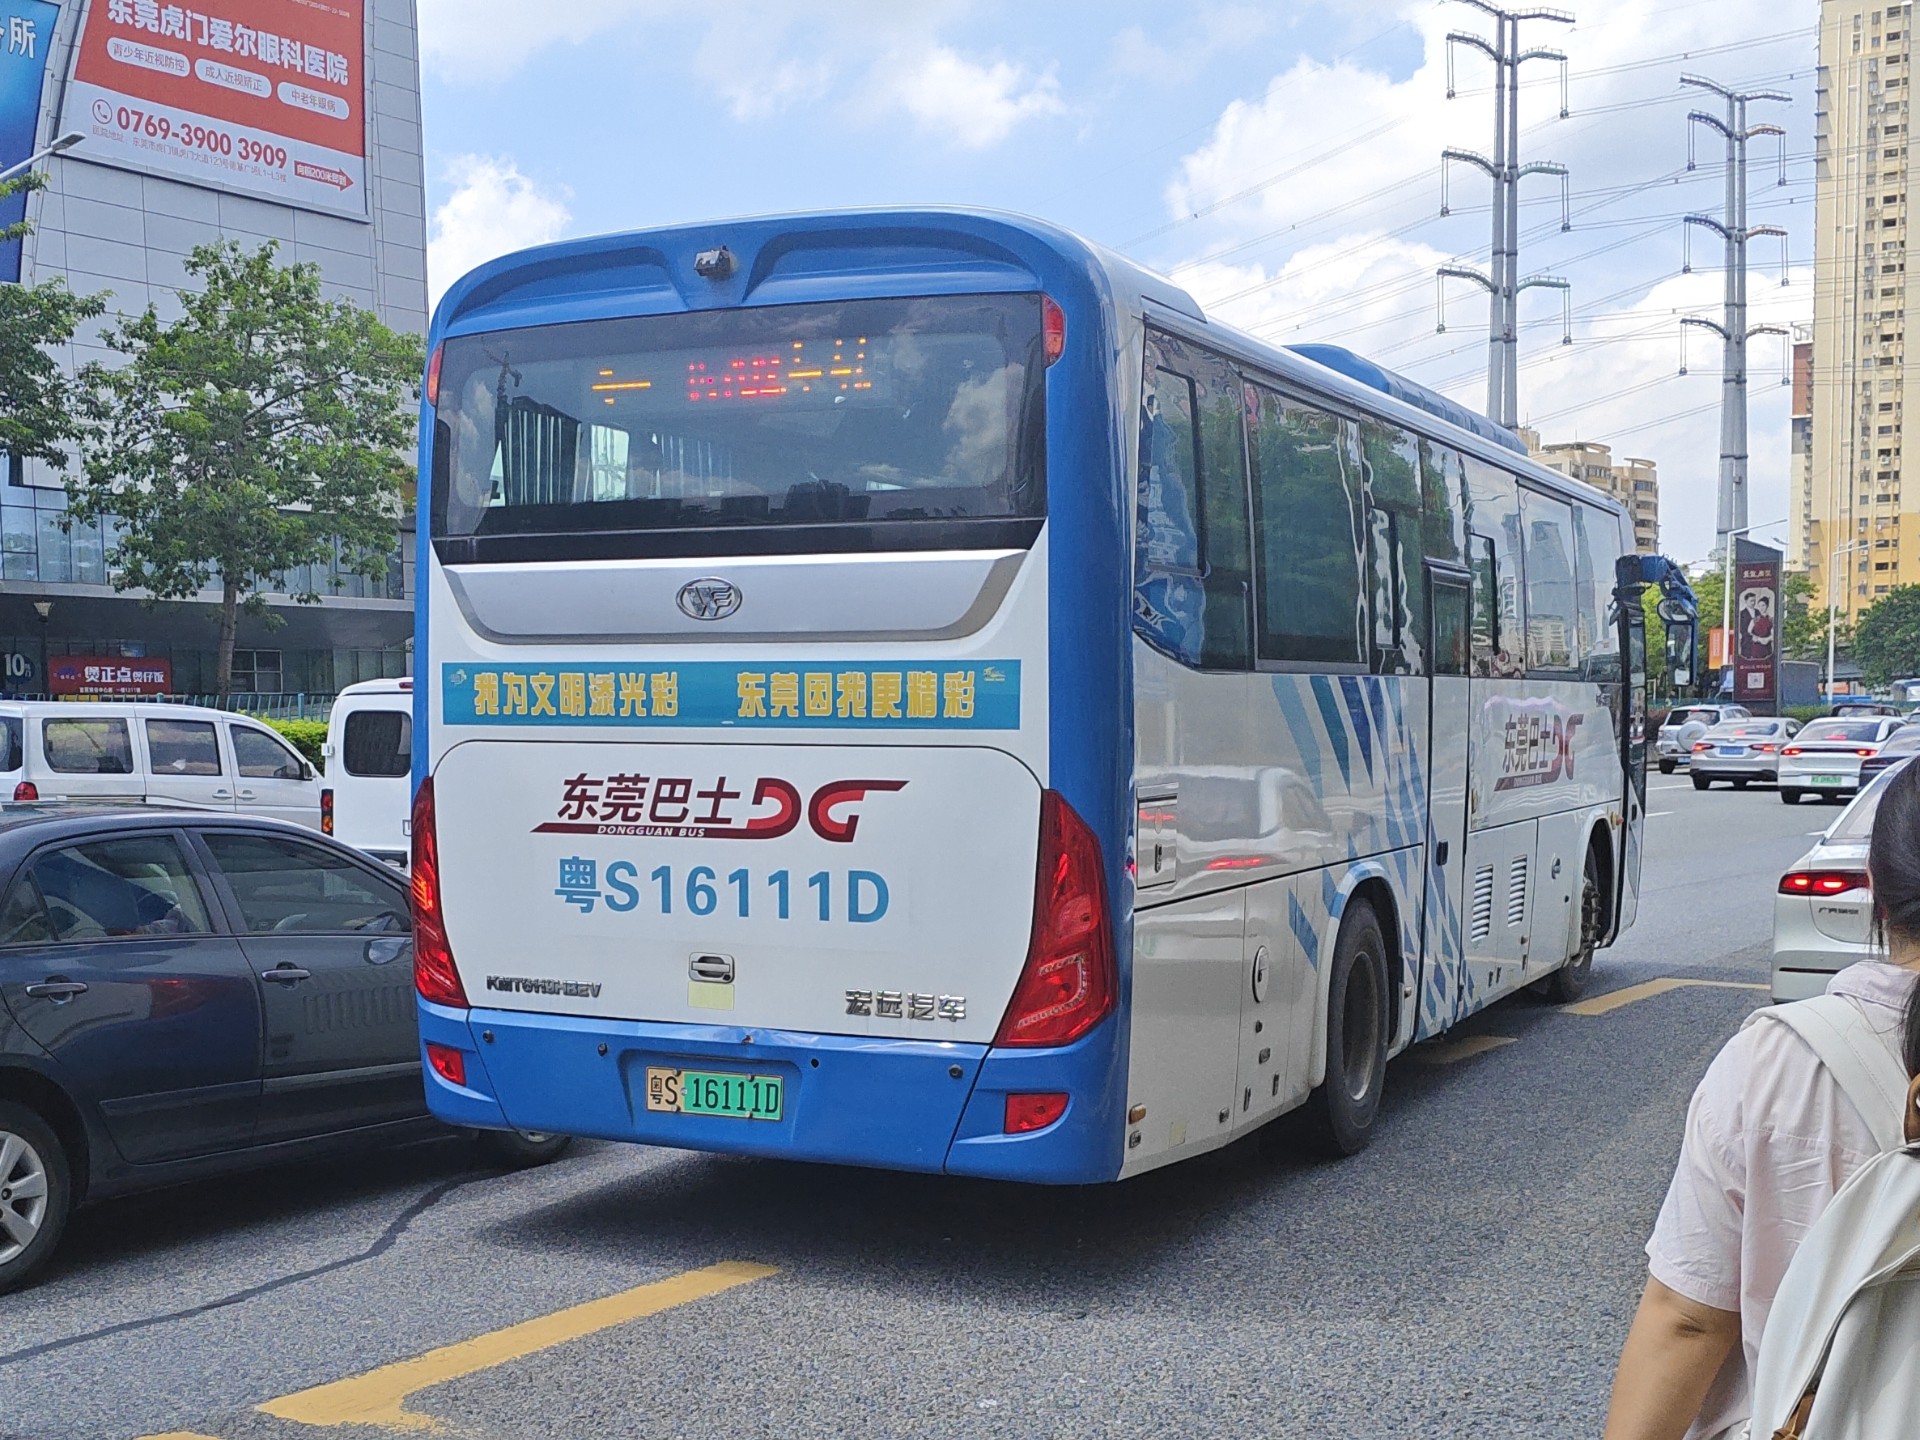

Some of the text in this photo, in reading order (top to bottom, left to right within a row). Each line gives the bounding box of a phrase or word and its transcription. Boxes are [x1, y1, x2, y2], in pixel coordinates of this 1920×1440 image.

[107, 0, 349, 86] 东莞虎门爱尔眼科医院
[112, 42, 186, 73] 青少年近视防控
[204, 65, 263, 92] 成人近视矫正
[116, 106, 288, 169] 0769-3900 3909
[736, 670, 976, 719] 东莞因我更精彩
[556, 772, 741, 825] 东莞巴士
[597, 825, 706, 838] DONGGUAN BUS
[554, 856, 890, 924] 粤S16111D
